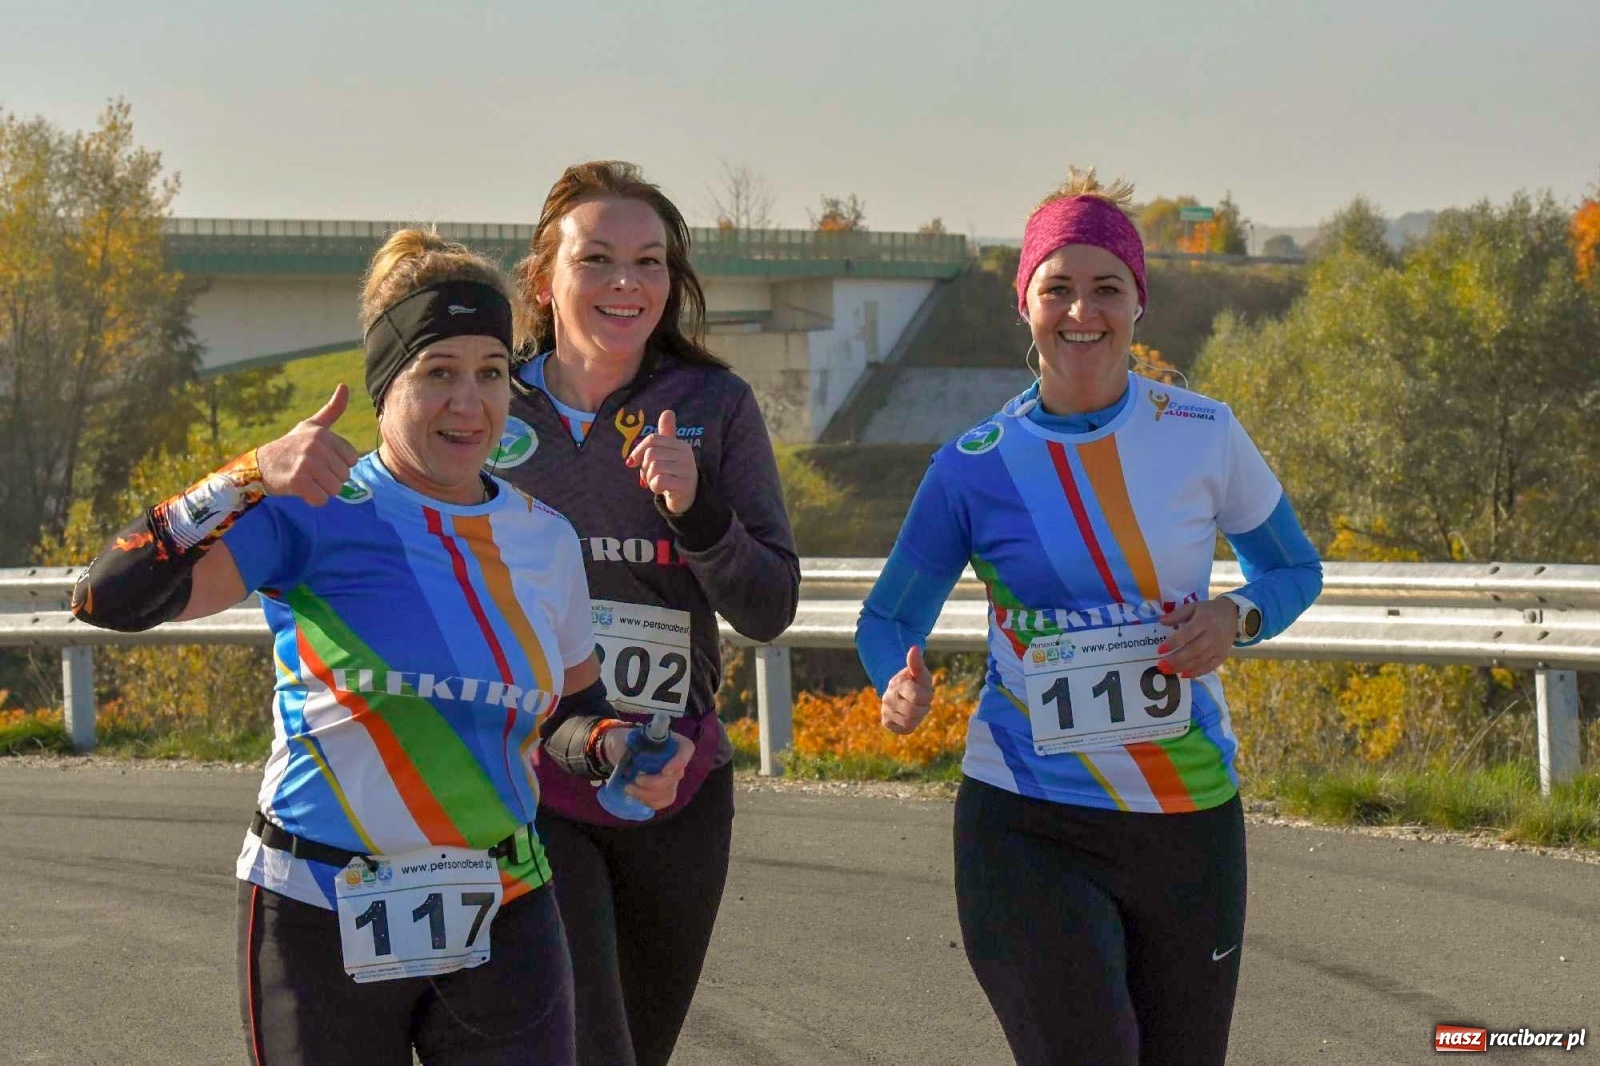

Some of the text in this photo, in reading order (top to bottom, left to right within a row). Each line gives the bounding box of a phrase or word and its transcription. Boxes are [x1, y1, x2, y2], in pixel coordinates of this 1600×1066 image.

[1001, 592, 1198, 631] ELEKTRO
[1081, 634, 1168, 654] www.personalbest
[1041, 665, 1182, 730] 119
[355, 892, 495, 957] 117
